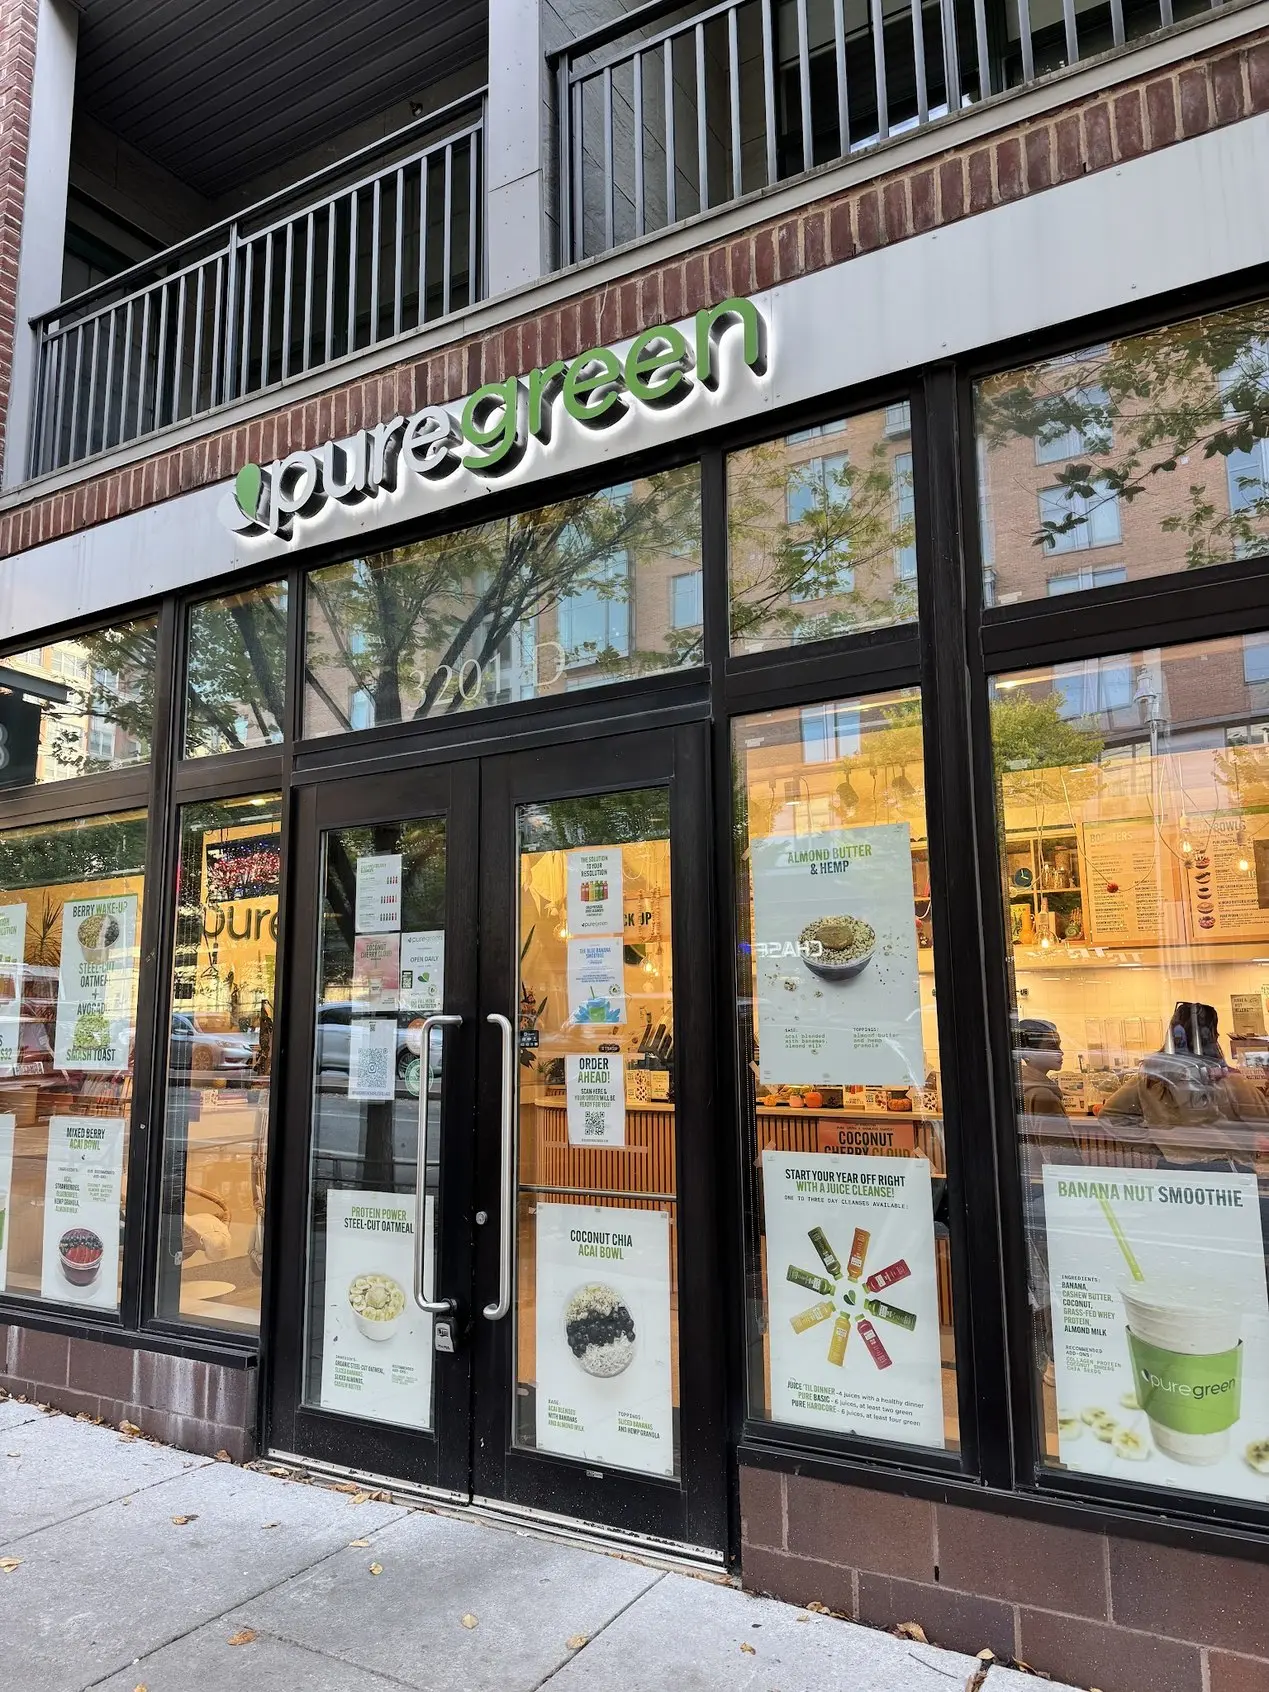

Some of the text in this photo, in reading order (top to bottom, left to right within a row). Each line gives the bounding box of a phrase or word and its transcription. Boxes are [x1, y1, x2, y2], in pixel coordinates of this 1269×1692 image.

[408, 653, 502, 711] 3201
[787, 844, 872, 864] ALMOND BUTTER
[581, 869, 607, 877] RESOLUTION
[810, 860, 849, 875] & HEMP
[73, 901, 128, 918] BERRY WAKE-UP
[66, 1049, 116, 1061] SMASH TOAST
[579, 1058, 609, 1070] ORDER
[578, 1071, 610, 1084] AHEAD!
[66, 1127, 105, 1139] MIXED BERRY
[838, 1131, 894, 1147] COCONUT
[69, 1139, 100, 1150] ACAI BOWL
[785, 1169, 905, 1187] START YOUR YEAR OFF RIGHT
[796, 1181, 895, 1198] WITH A JUICE CLEANSE!
[1058, 1180, 1244, 1208] BANANA NUT SMOOTHIE
[841, 1199, 869, 1207] CLEANSES
[351, 1206, 407, 1221] PROTEIN POWER
[344, 1218, 414, 1234] STEEL-CUT OATMEAL
[570, 1230, 633, 1248] COCONUT CHIA
[578, 1244, 624, 1260] ACAI BOWL
[1062, 1282, 1088, 1291] BANANA,
[1062, 1290, 1114, 1302] CASHEW BUTTER,
[1063, 1299, 1093, 1309] COCONUT,
[1064, 1308, 1115, 1319] GRASS-FED WHEY
[1064, 1316, 1091, 1327] PROTEIN,
[1065, 1325, 1107, 1336] ALMOND MILK
[1065, 1345, 1102, 1353] RECOMMENDED
[1149, 1374, 1236, 1400] puregreen
[787, 1381, 802, 1390] JUICE
[813, 1384, 835, 1395] DINNER
[843, 1391, 860, 1400] juices
[862, 1393, 875, 1401] with
[881, 1396, 903, 1406] healthy
[904, 1400, 924, 1409] dinner
[798, 1391, 813, 1400] PURE
[813, 1393, 830, 1403] BASIC
[840, 1400, 859, 1409] juices,
[882, 1406, 893, 1414] two
[895, 1408, 913, 1416] green
[557, 1407, 576, 1415] BLENDED
[791, 1399, 806, 1408] PURE
[807, 1402, 836, 1413] HARDCORE
[846, 1409, 865, 1419] juices,
[874, 1413, 887, 1421] least
[559, 1414, 577, 1423] BANANAS
[618, 1418, 653, 1430] SLICED BANANAS
[557, 1421, 573, 1430] ALMOND
[627, 1427, 639, 1435] HEMP
[640, 1430, 660, 1439] GRANOLA
